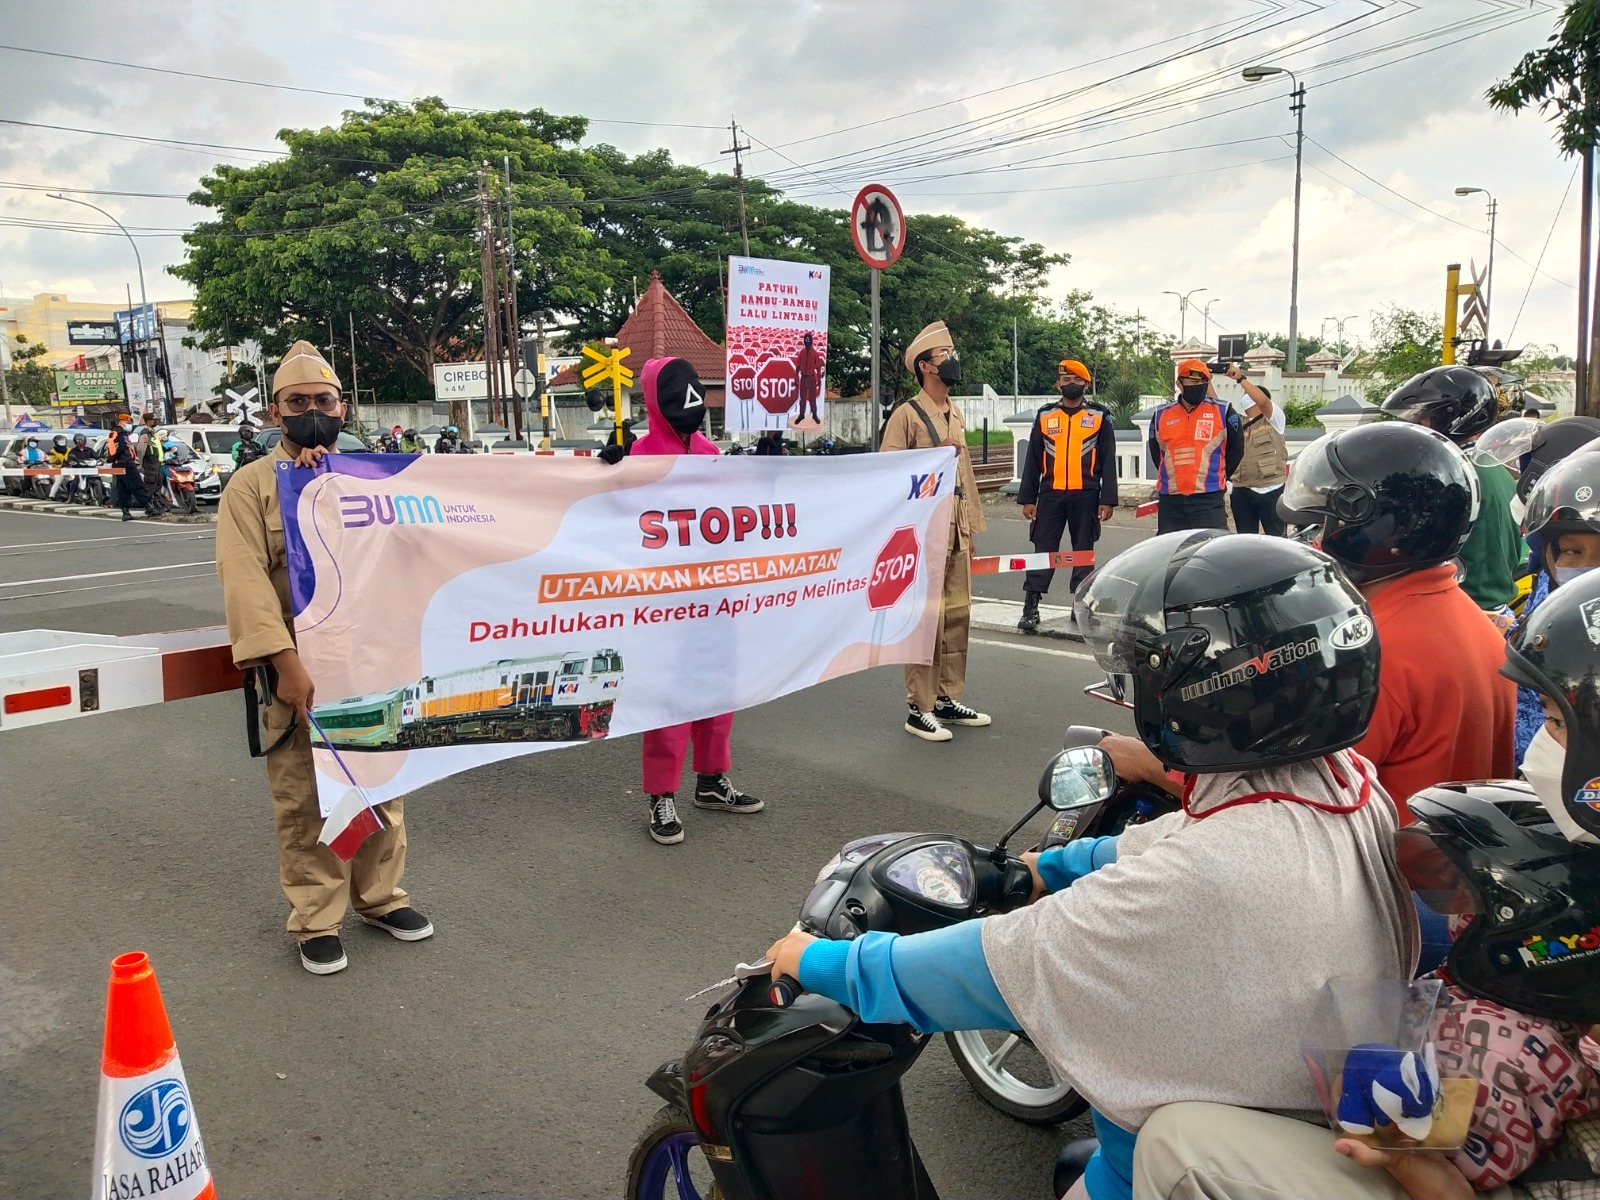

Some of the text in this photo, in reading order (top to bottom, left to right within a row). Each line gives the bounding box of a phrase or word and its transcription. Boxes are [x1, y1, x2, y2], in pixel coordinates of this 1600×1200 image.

[758, 282, 798, 295] PATUHI
[741, 295, 818, 311] RAMBU-RAMBU
[740, 309, 817, 323] LALU LINTAS!!
[443, 370, 489, 382] CIREBO
[760, 378, 797, 399] STOP
[907, 472, 945, 500] KAI
[443, 504, 476, 513] UNTUK
[446, 514, 497, 523] INDONESIA
[638, 503, 797, 550] STOP!!!
[543, 551, 841, 599] UTAMAKAN KESELAMATAN
[872, 553, 915, 586] STOP
[470, 577, 868, 643] Dahulukan Kereta Api yang Melintas
[558, 683, 579, 694] KAI
[104, 1139, 206, 1200] JASA RAHAR
